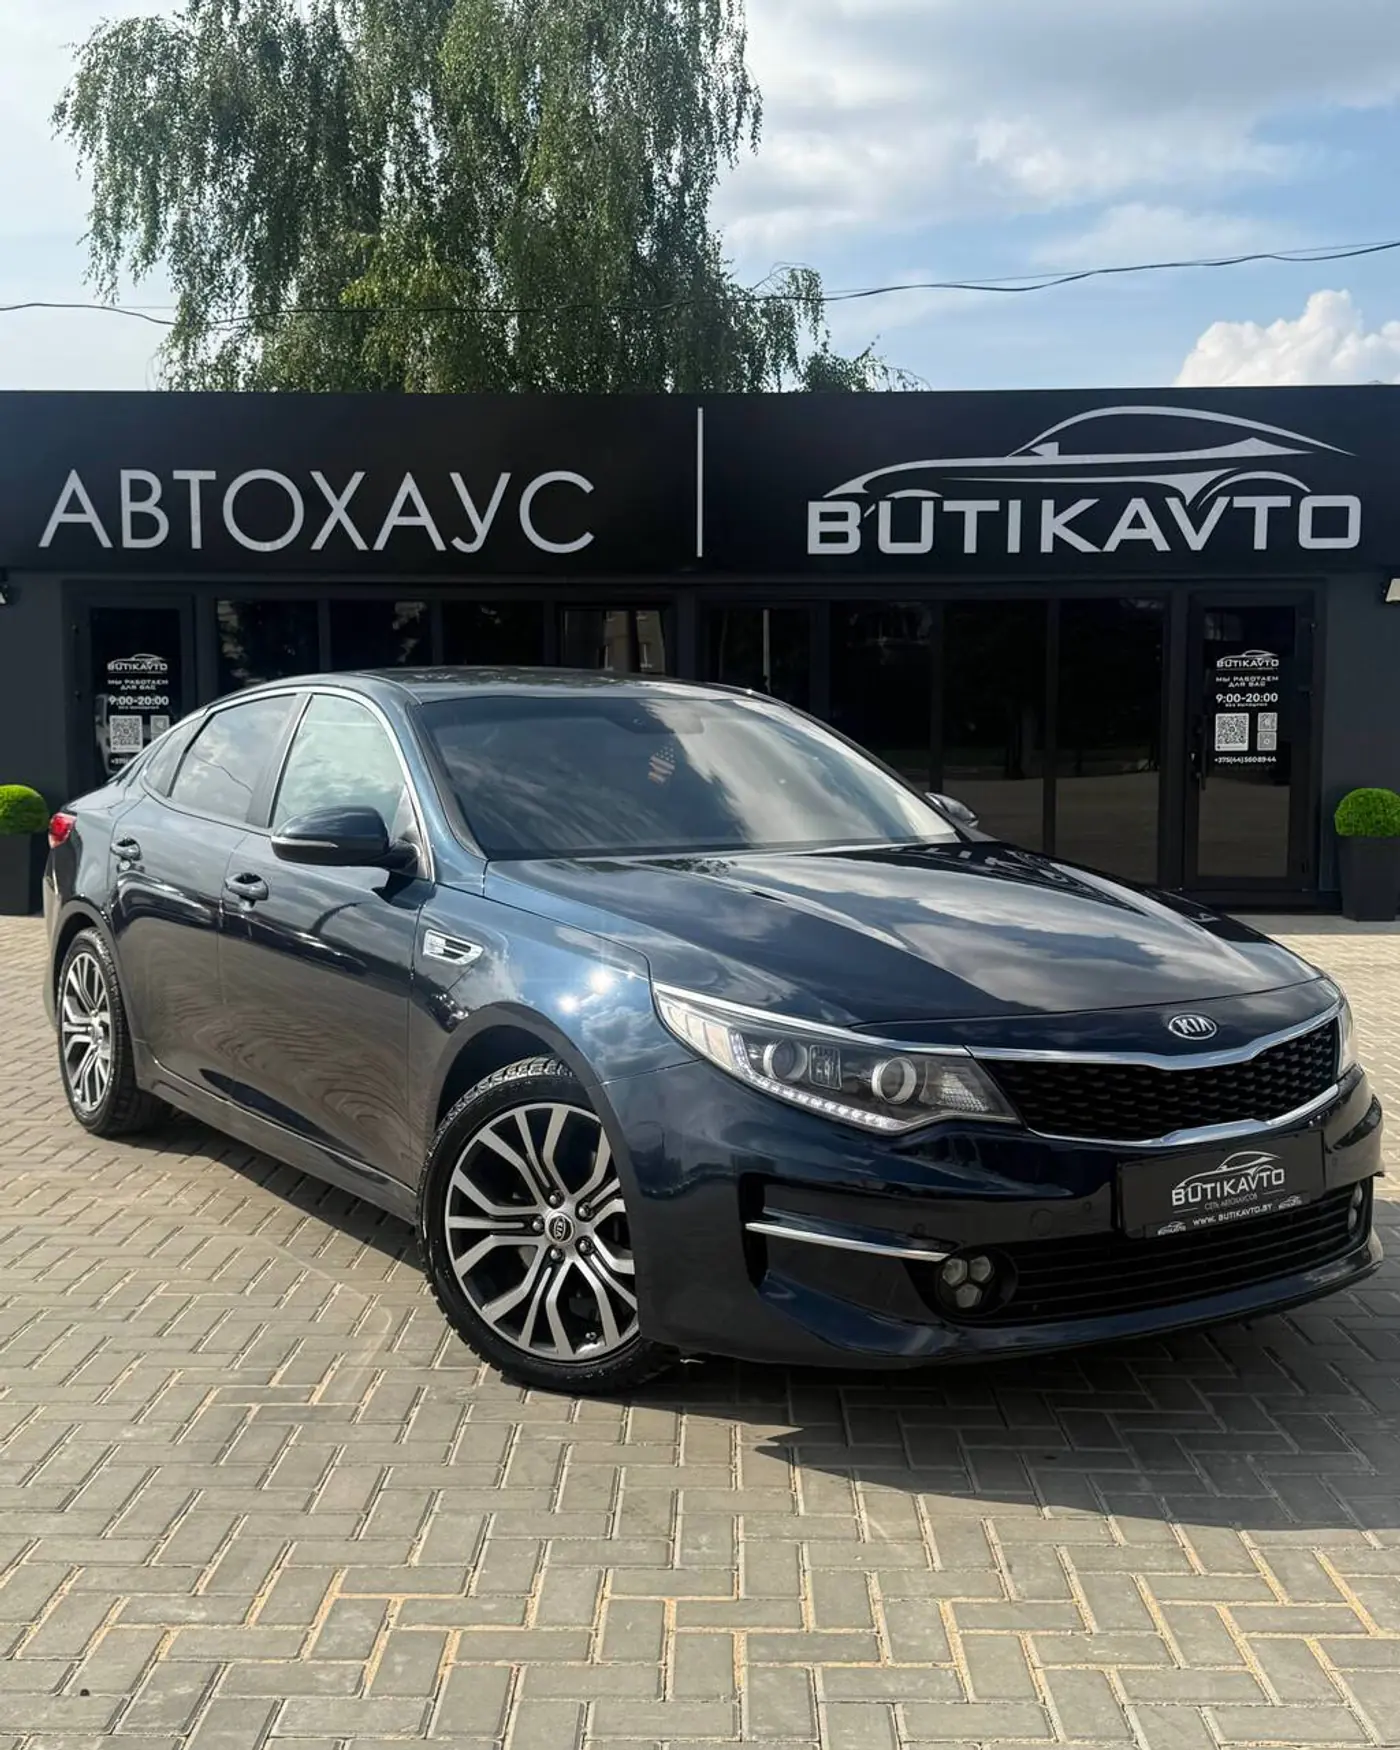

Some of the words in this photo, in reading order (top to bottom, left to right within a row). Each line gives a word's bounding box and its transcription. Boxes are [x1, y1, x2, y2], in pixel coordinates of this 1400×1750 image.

[38, 468, 595, 554] АВТОХАУС
[806, 494, 1362, 556] BUTIKAVTO
[108, 696, 169, 706] 9:00-20:00
[1216, 693, 1278, 703] 9:00-20:00
[1175, 1017, 1213, 1034] KIA
[1171, 1168, 1285, 1206] BUTIKAVTO
